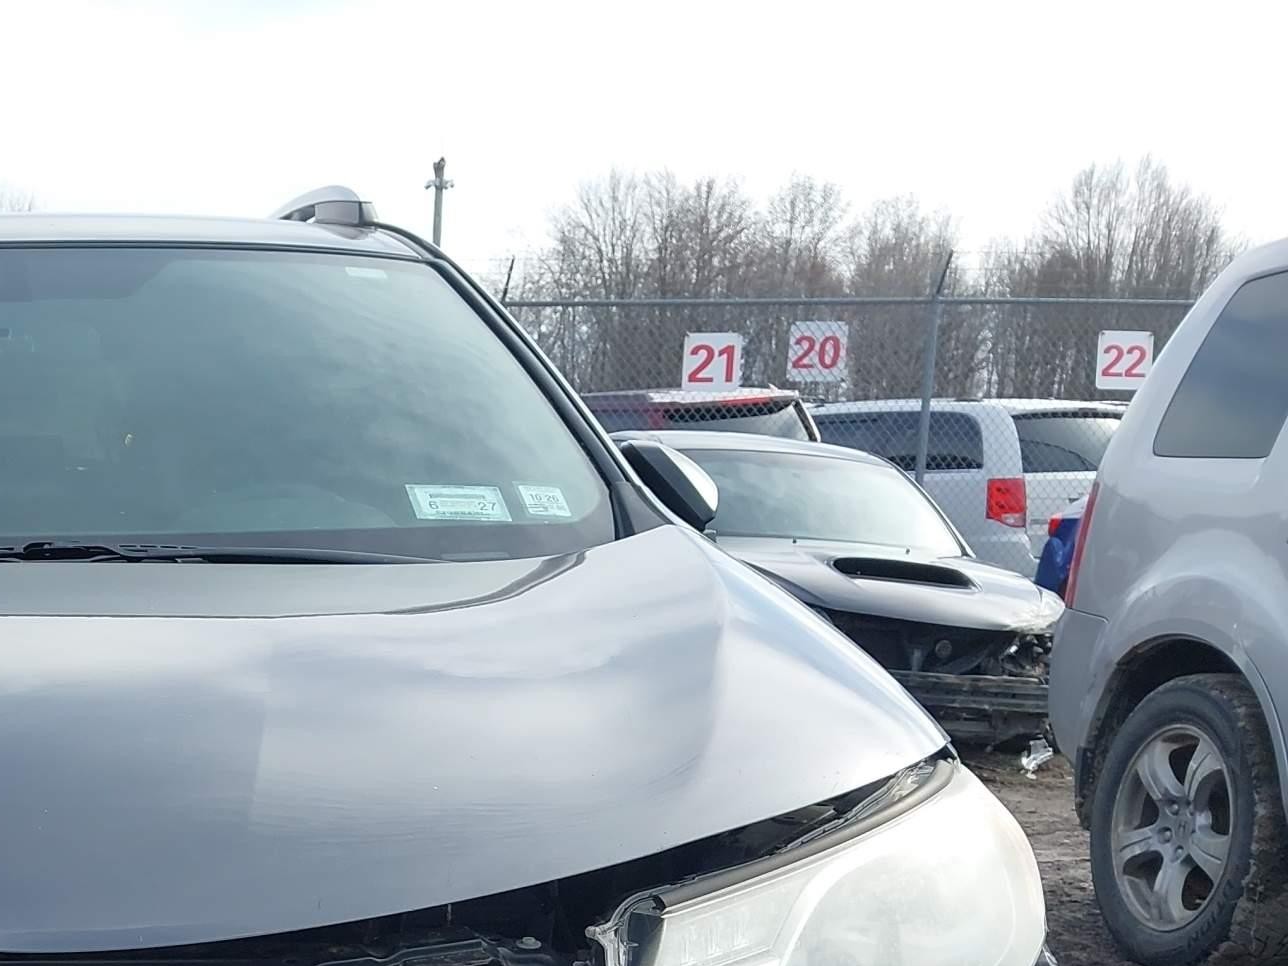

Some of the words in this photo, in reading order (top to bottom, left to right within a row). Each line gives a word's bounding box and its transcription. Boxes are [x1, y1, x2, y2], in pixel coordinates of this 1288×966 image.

[687, 344, 736, 383] 21
[792, 335, 841, 369] 20
[1101, 344, 1147, 378] 22
[428, 500, 439, 510] 6
[477, 501, 497, 512] 27
